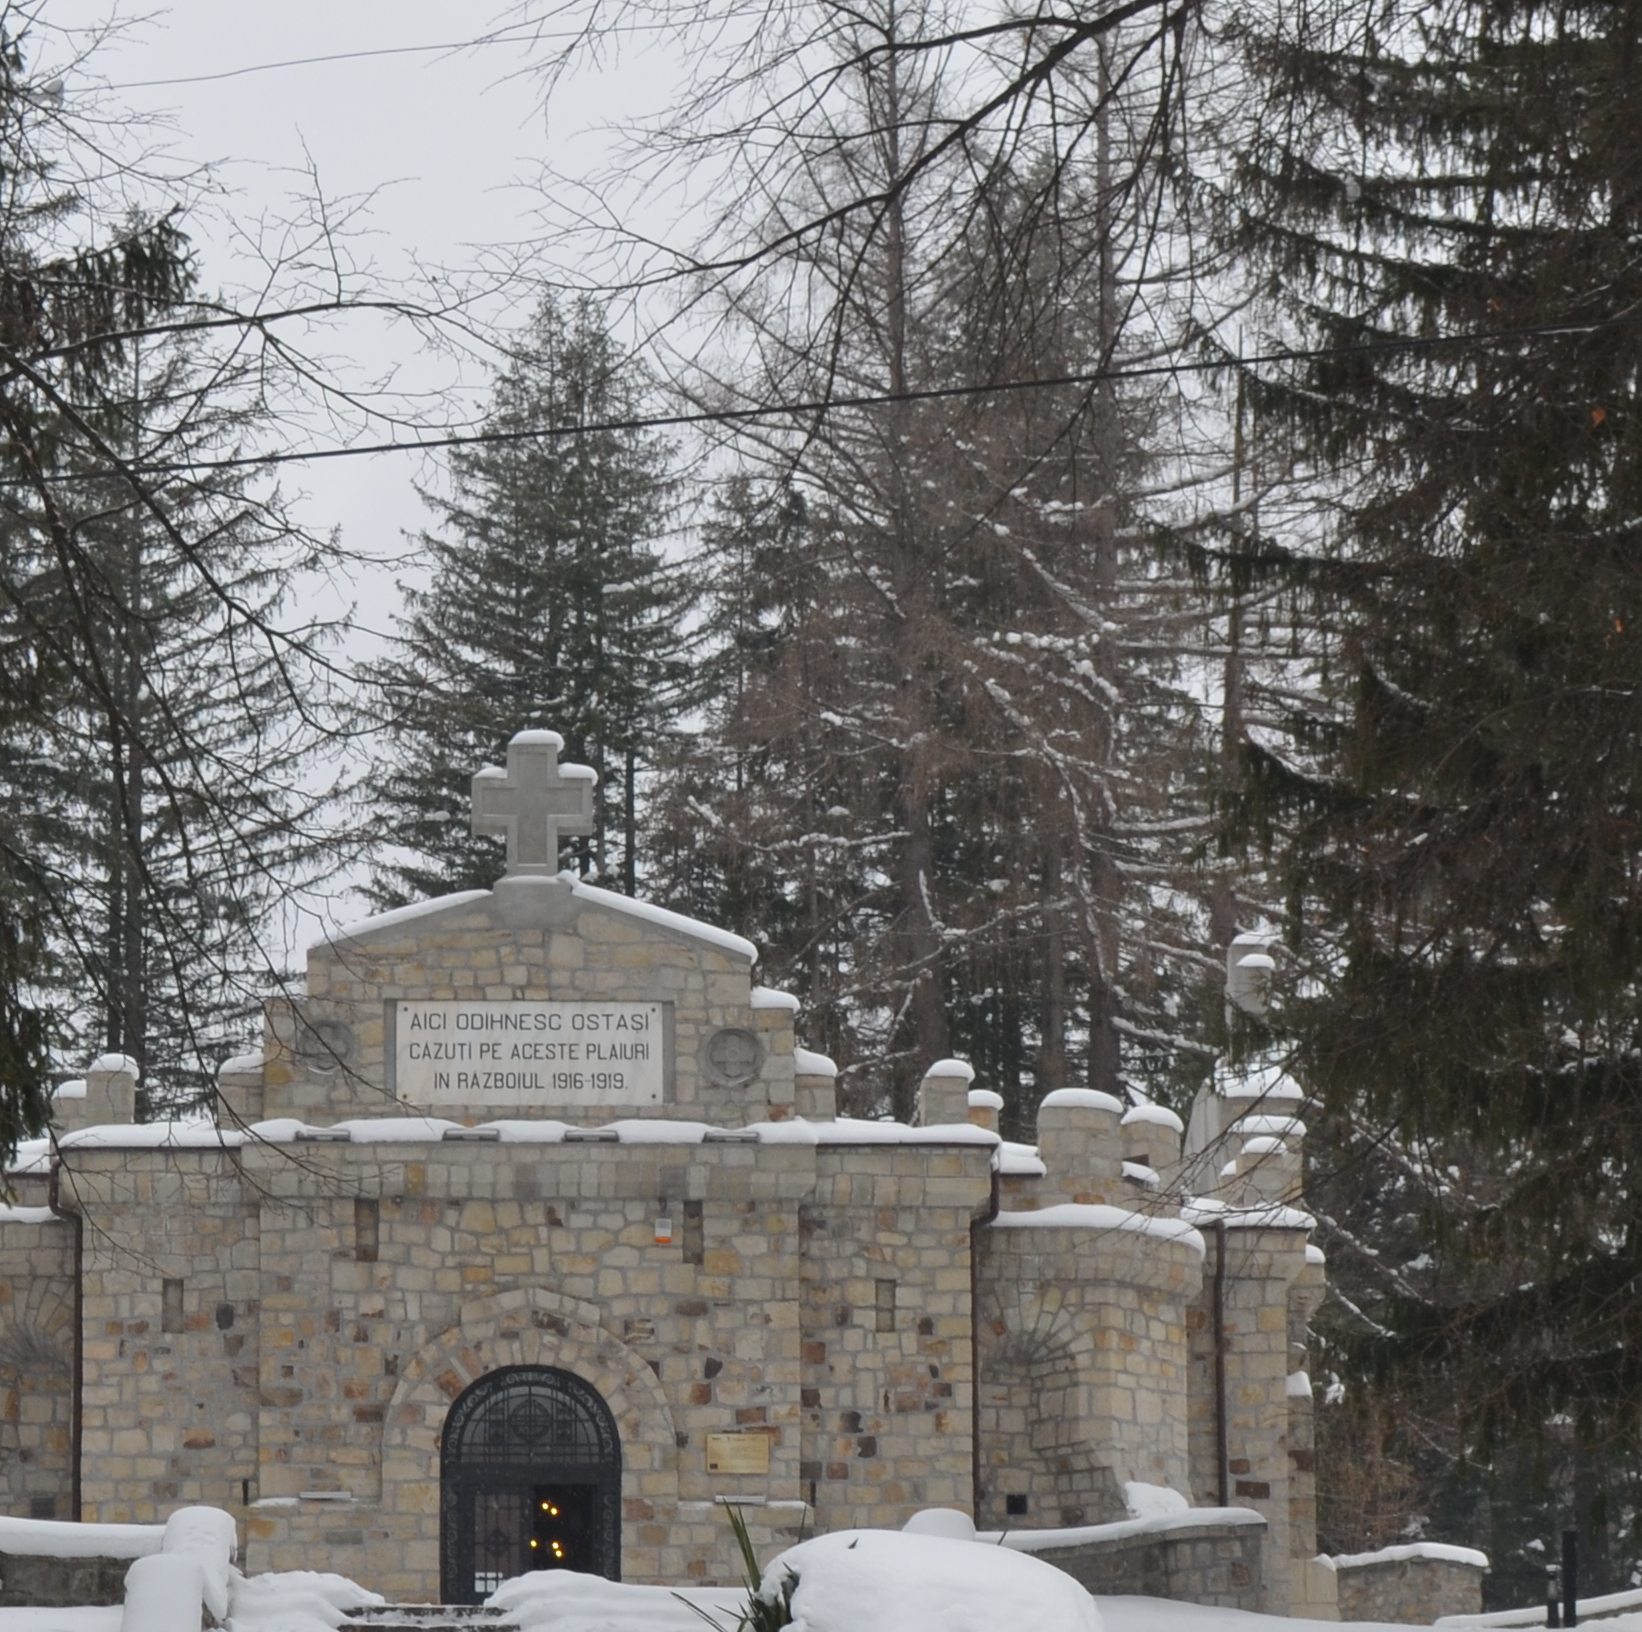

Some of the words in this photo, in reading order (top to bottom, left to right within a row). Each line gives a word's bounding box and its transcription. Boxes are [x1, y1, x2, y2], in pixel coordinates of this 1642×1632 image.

[410, 1012, 446, 1030] AICI
[456, 1012, 562, 1030] ODIHNESC
[480, 1043, 502, 1060] PE
[511, 1043, 579, 1060] ACESTE
[586, 1043, 649, 1060] PLAIURI
[553, 1073, 628, 1089] 1916-1919.
